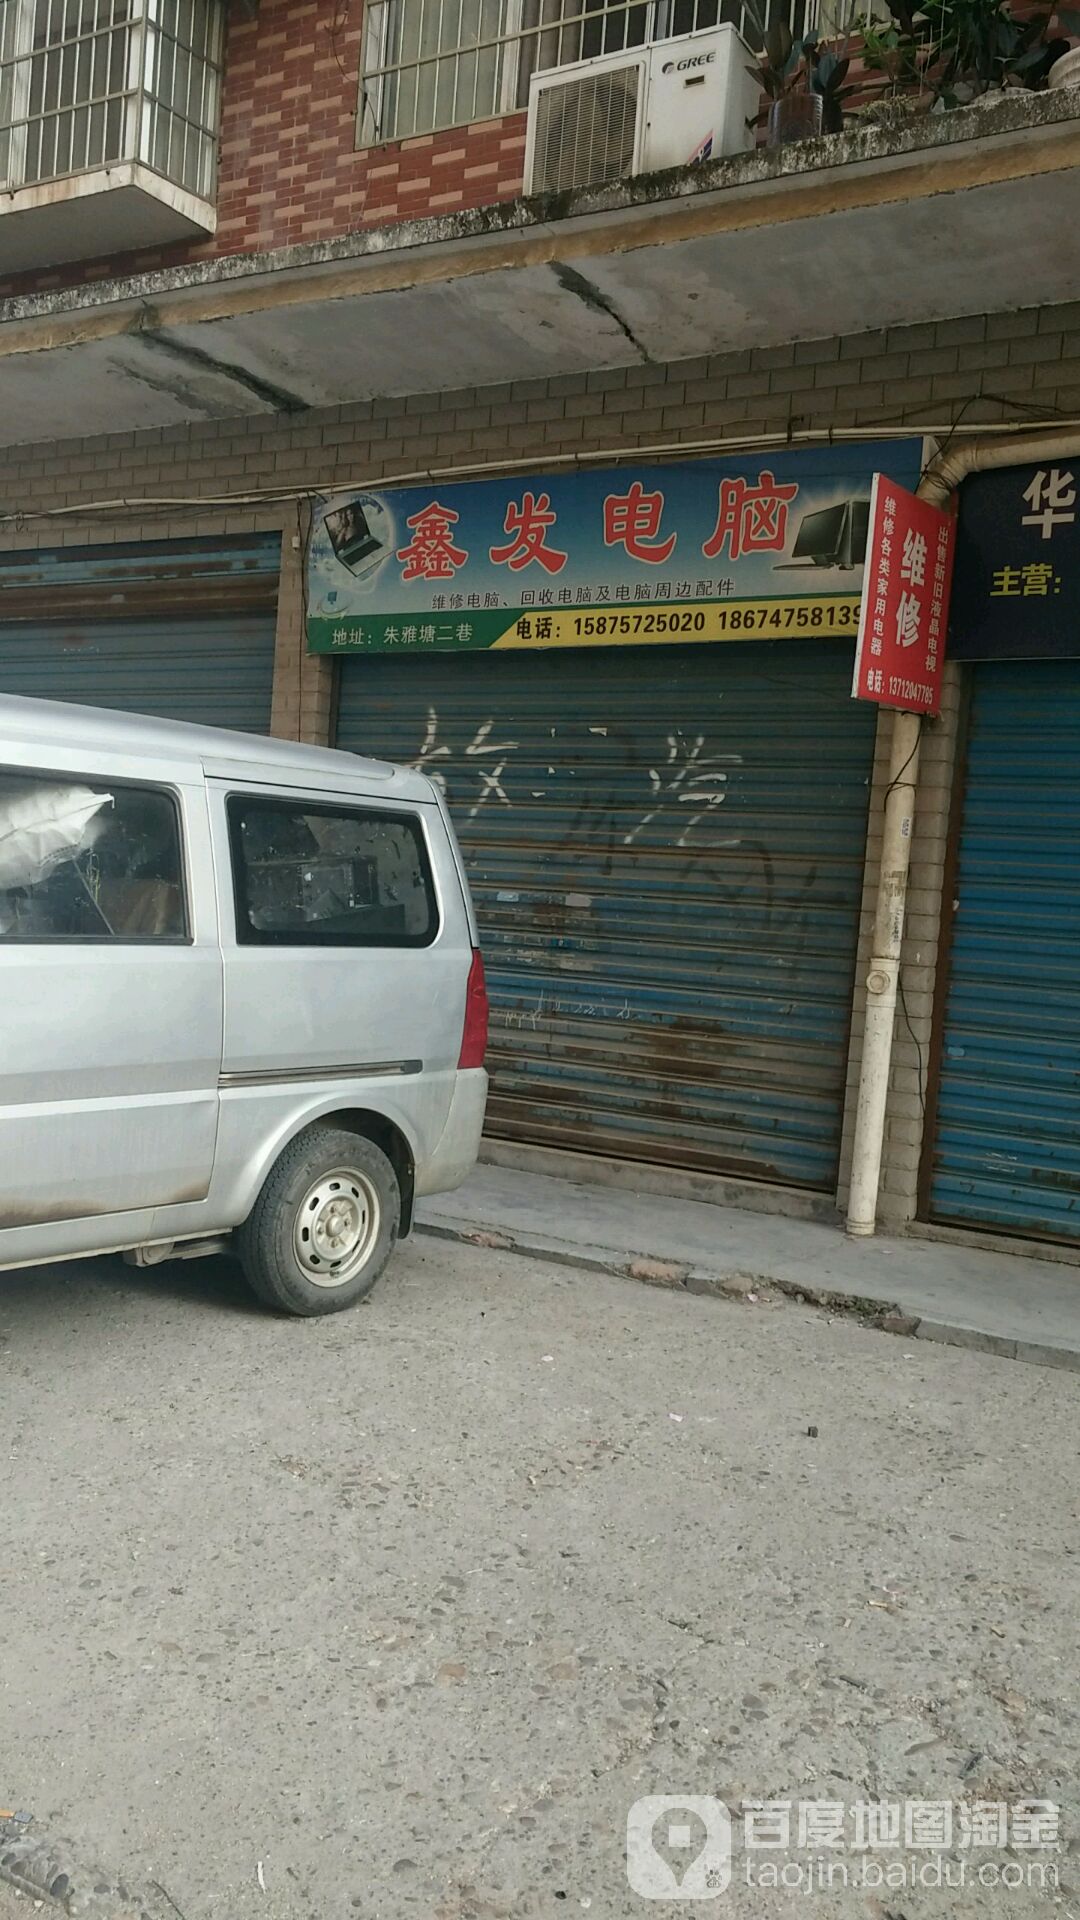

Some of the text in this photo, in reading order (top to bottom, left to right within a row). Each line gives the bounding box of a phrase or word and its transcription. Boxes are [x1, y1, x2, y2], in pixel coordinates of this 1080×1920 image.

[677, 52, 716, 71] GREE
[397, 470, 799, 580] 鑫发电脑
[1021, 469, 1077, 540] 华
[431, 578, 736, 609] 维修电脑、回收电脑及电脑周边配件
[870, 496, 896, 657] 维修各类家用电器
[896, 528, 927, 648] 维修
[925, 526, 949, 673] 出售新旧液晶电视
